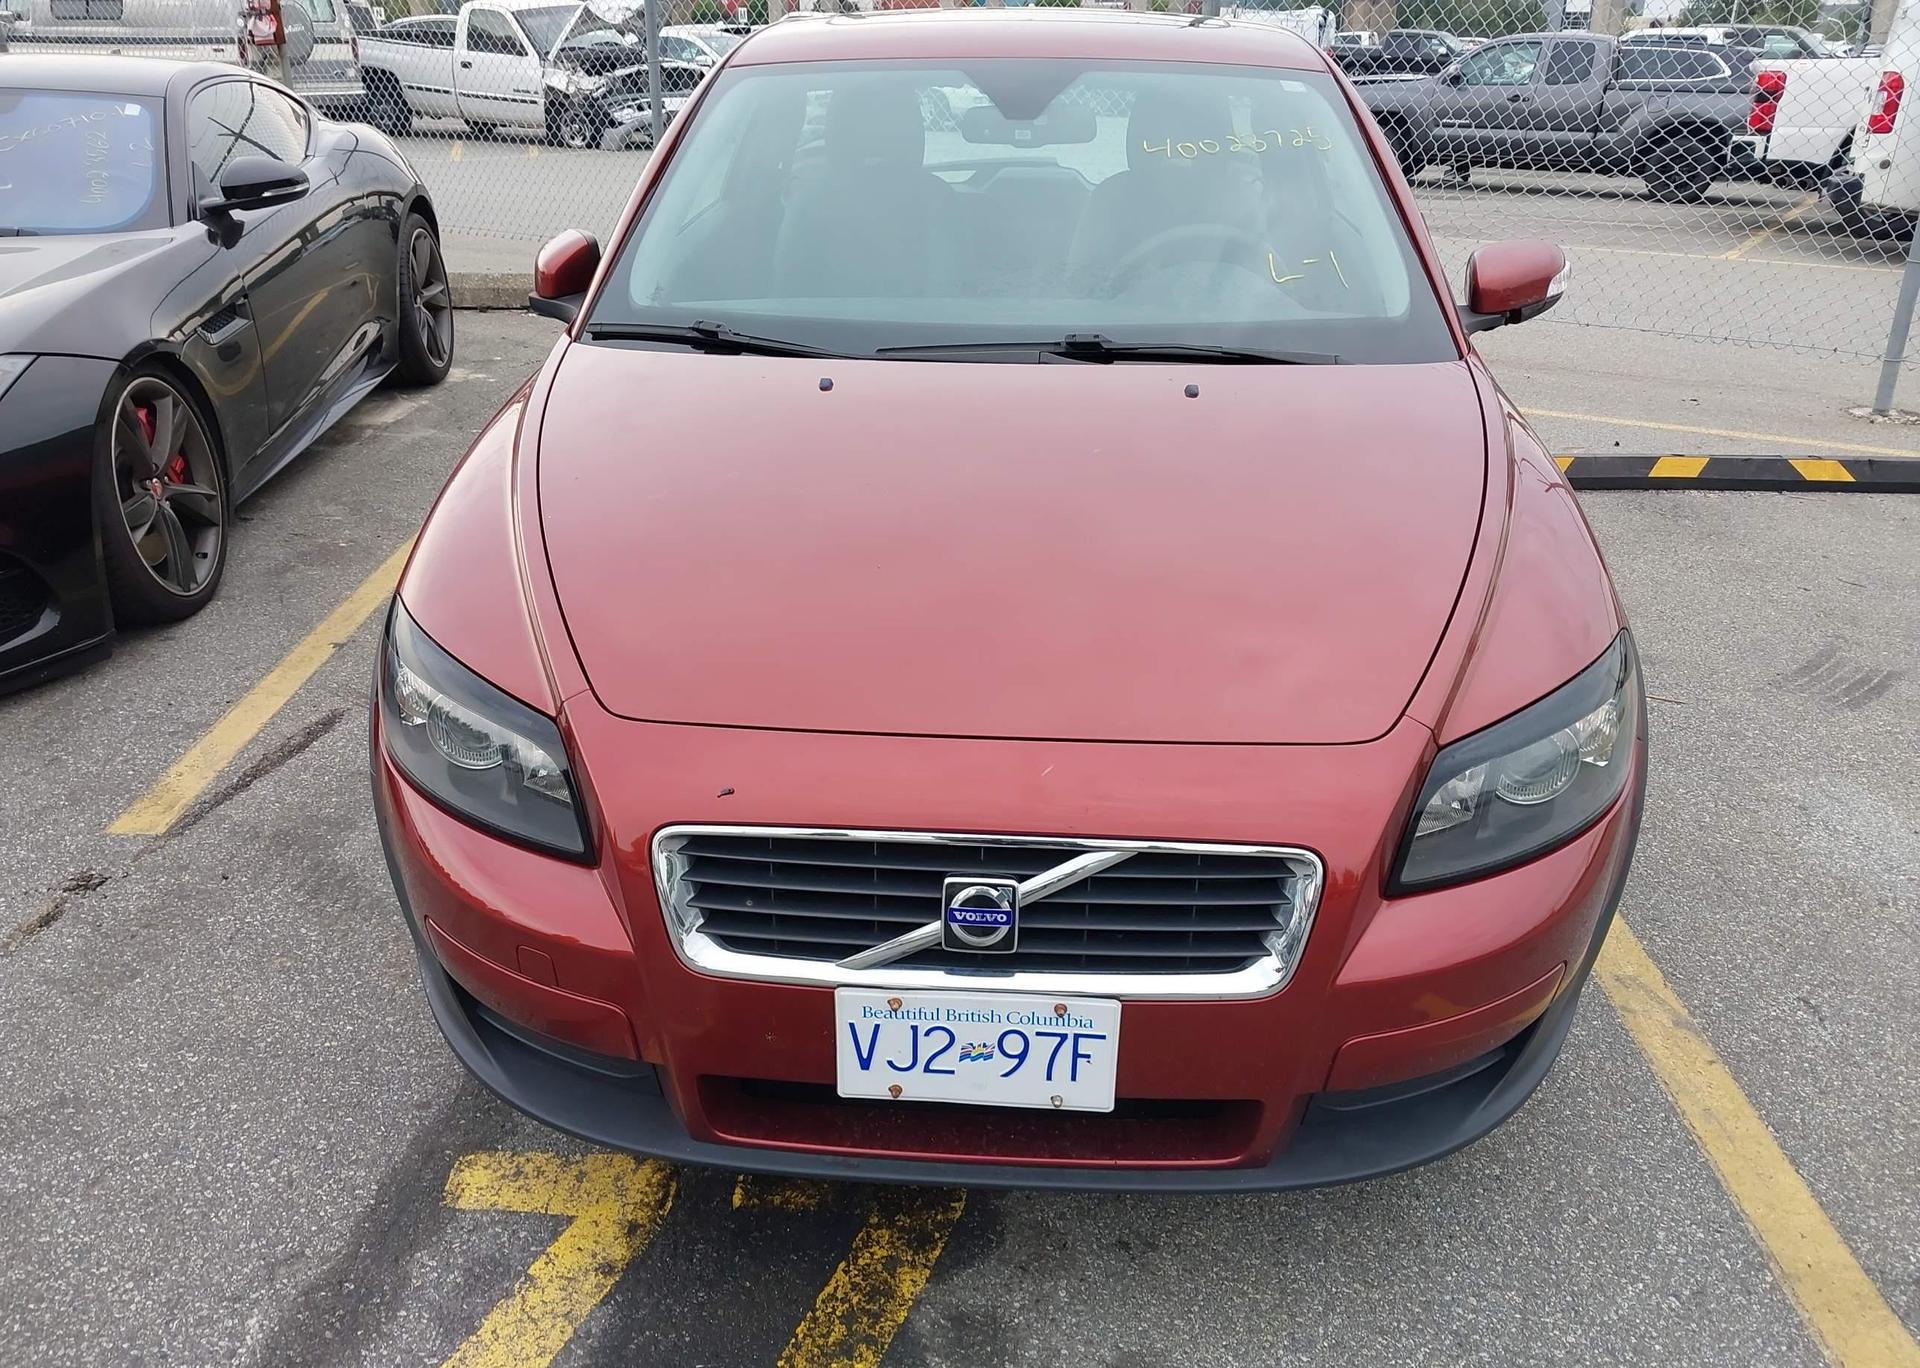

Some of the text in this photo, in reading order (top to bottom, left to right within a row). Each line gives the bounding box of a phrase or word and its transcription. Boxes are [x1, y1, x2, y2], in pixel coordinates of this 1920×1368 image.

[953, 911, 1007, 922] VOLVO
[862, 1005, 1094, 1029] Beautiful British Columbia
